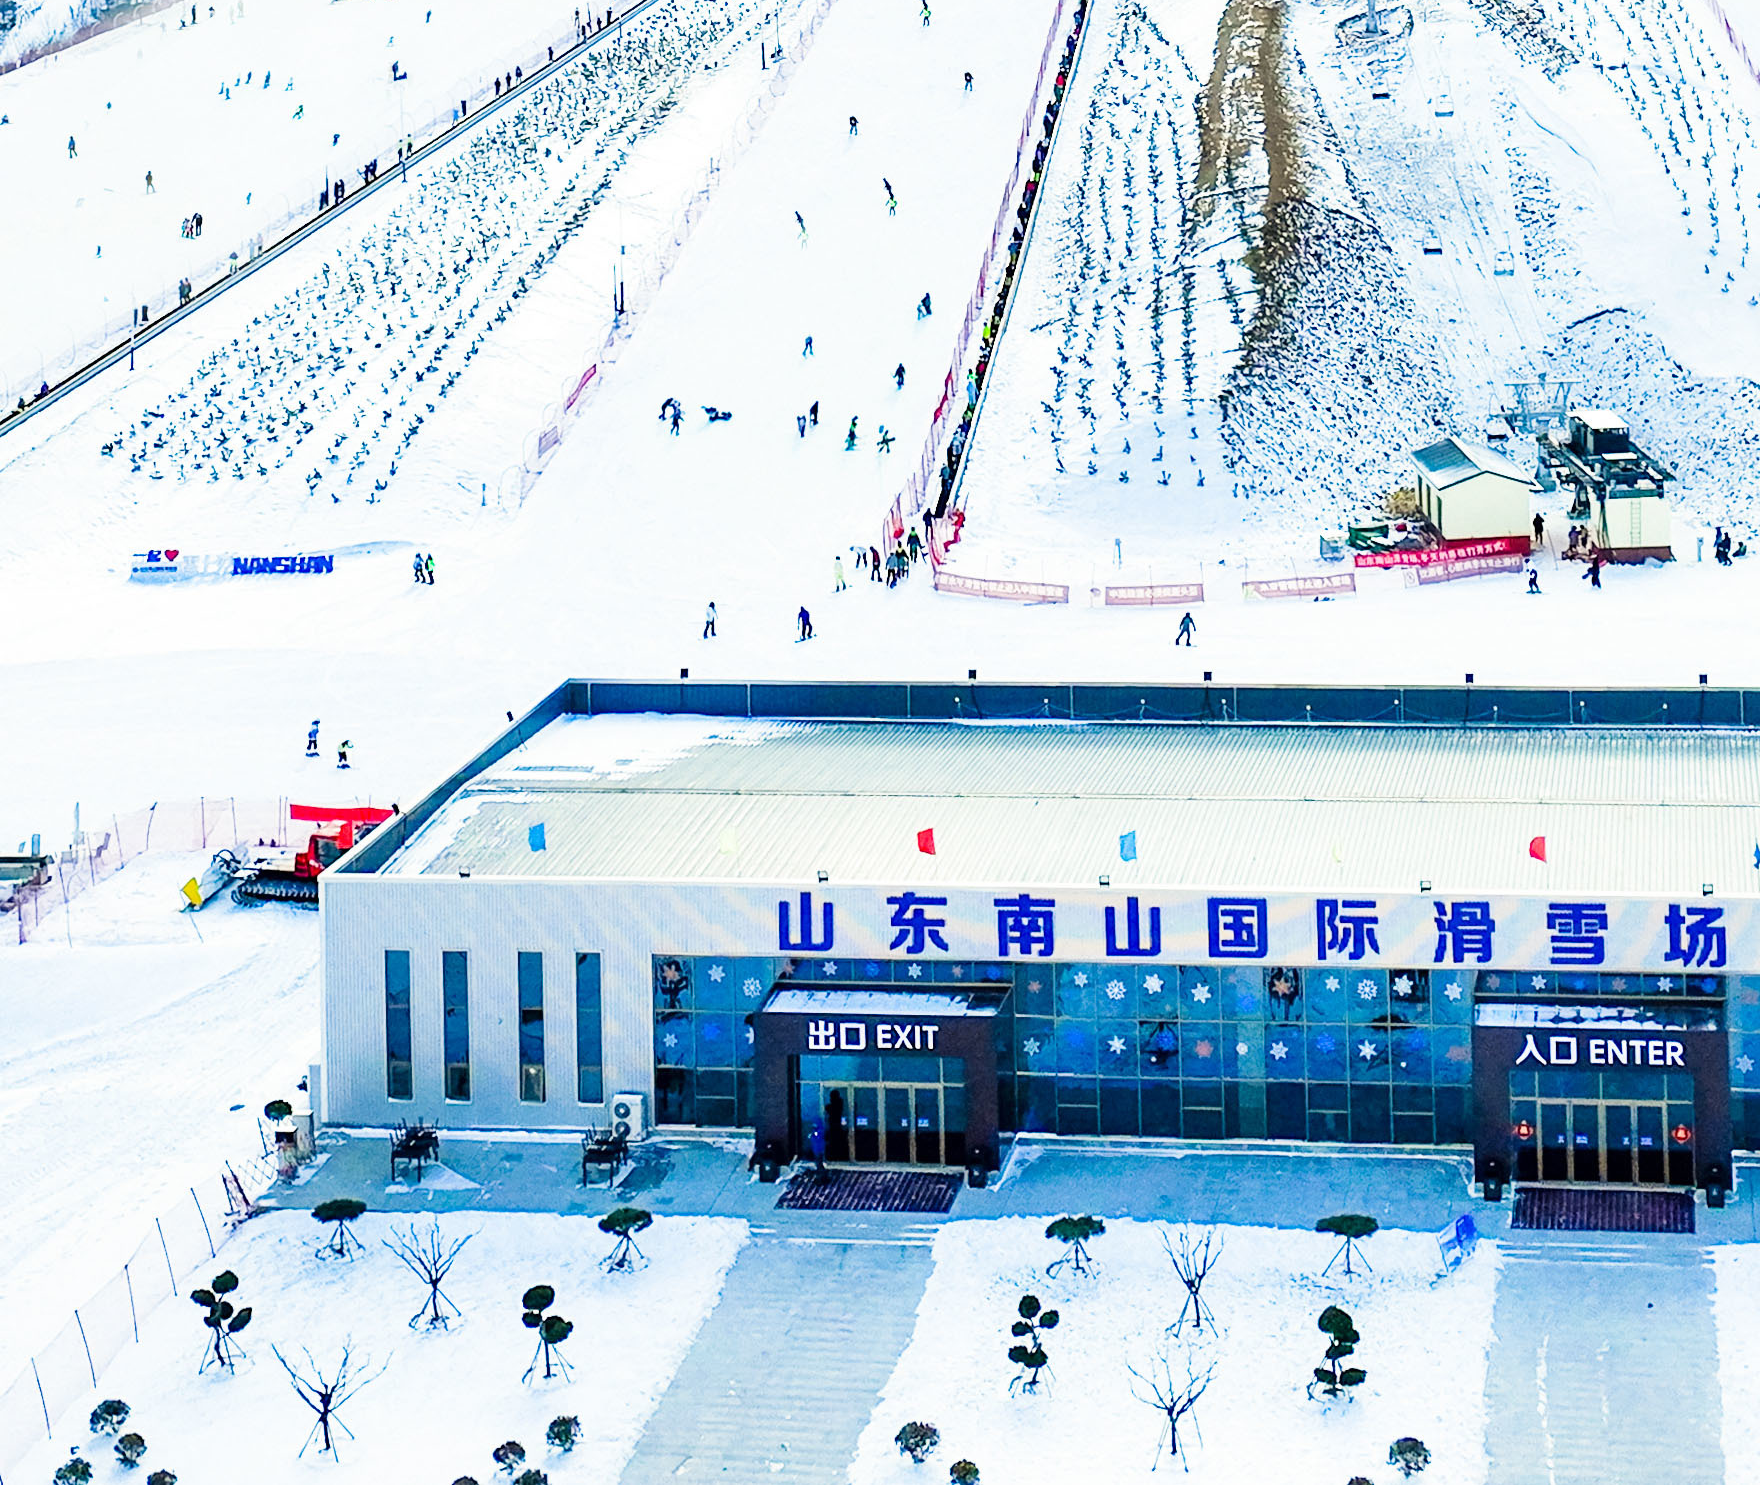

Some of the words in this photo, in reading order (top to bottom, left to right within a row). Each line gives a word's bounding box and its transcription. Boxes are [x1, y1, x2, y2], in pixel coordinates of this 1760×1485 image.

[232, 554, 334, 576] NANSHAN
[778, 891, 1727, 968] 山东南山国际滑雪场
[807, 1020, 867, 1050] 出口
[876, 1024, 939, 1050] EXIT
[1515, 1034, 1578, 1066] 入口
[1590, 1039, 1686, 1066] ENTER
